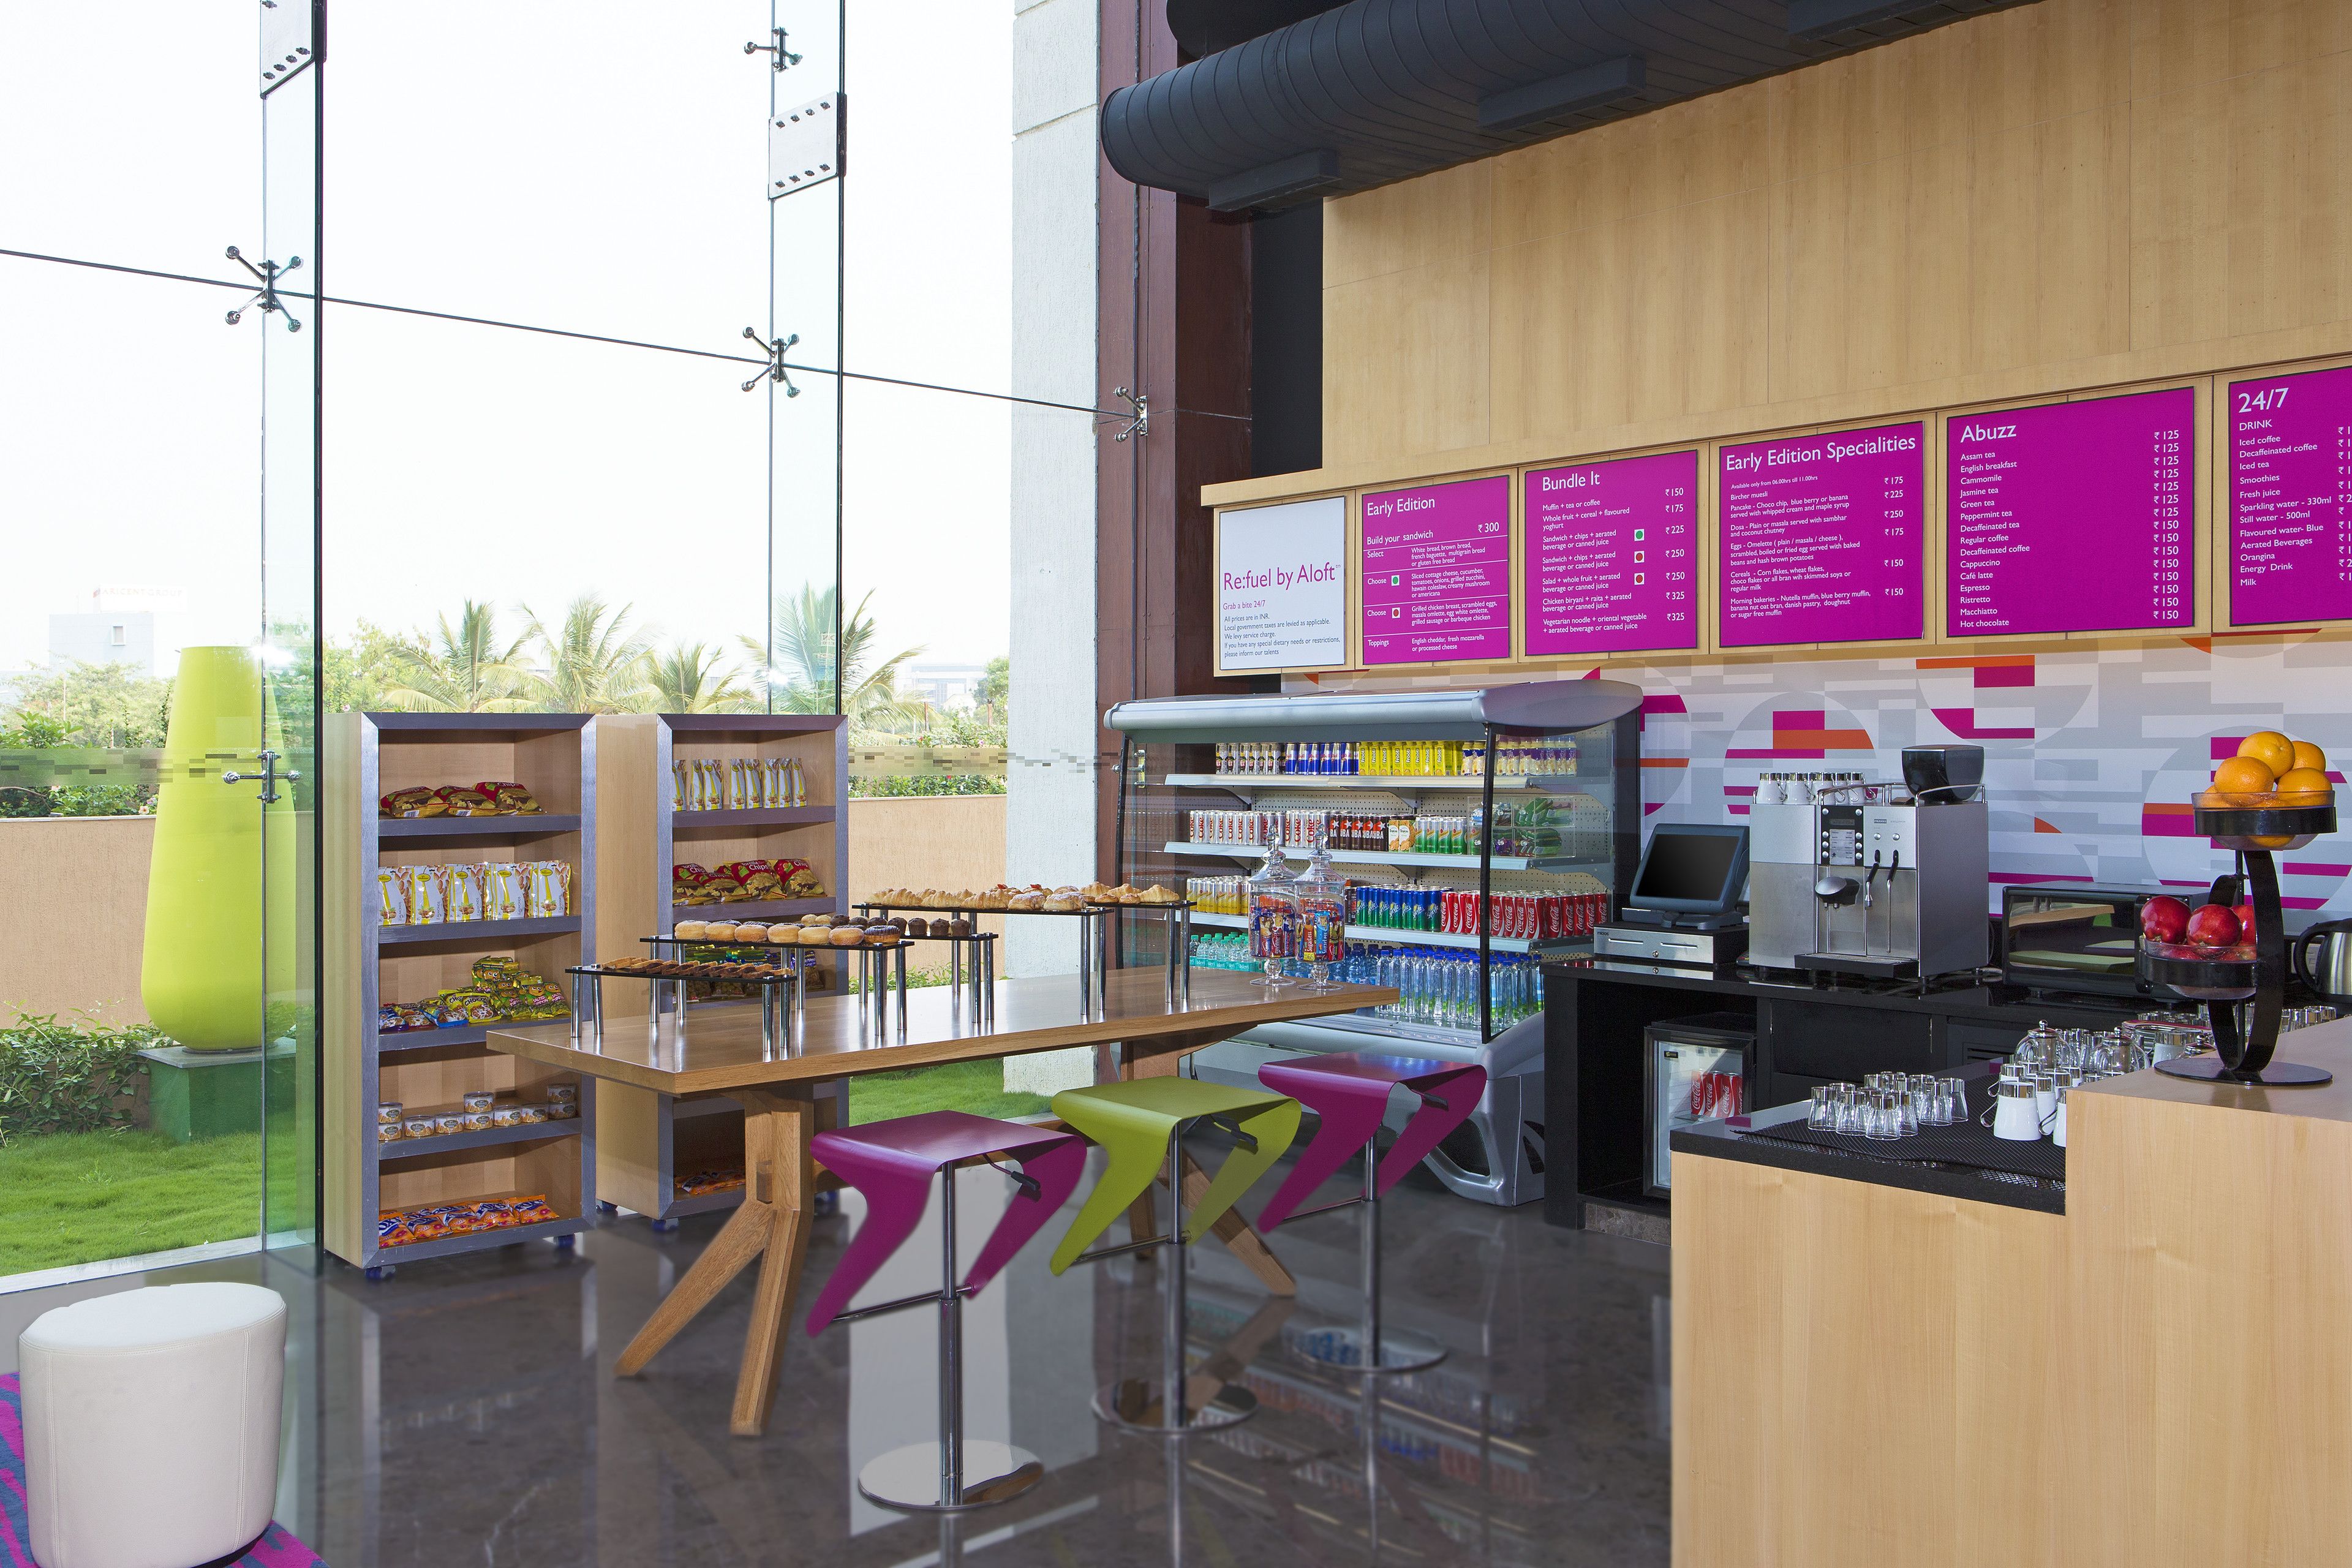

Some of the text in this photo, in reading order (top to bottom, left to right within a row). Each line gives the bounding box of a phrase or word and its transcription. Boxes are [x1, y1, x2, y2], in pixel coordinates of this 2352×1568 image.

[2238, 387, 2288, 413] 24/7
[2239, 419, 2272, 431] DRINK
[1960, 424, 2016, 443] Abuzz
[2239, 435, 2280, 446] Iced coffee
[1727, 435, 1915, 472] Early Edition Specialities
[2239, 443, 2317, 458] Decaffeinated coffee
[1961, 461, 2017, 473] English breakfast
[2239, 461, 2255, 470] Iced
[1542, 470, 1600, 491] Bundle It
[1960, 474, 2002, 484] Cammomile
[2240, 475, 2280, 484] Smoothies
[1960, 488, 1986, 498] Jasmine
[2263, 489, 2280, 498] juice
[1367, 497, 1434, 517] Early Edition
[2240, 502, 2274, 513] Sparkling
[2307, 496, 2331, 505] 330ml
[1604, 507, 1629, 516] flavoured
[1960, 511, 2000, 521] Peppermint
[2286, 510, 2310, 519] 500ml
[1542, 522, 1564, 532] yoghurt
[1960, 521, 2007, 532] Decaffeinated
[1366, 529, 1433, 545] Build your sandwich
[2240, 527, 2276, 537] Flavoured
[1960, 533, 2008, 545] Regular coffee
[2240, 540, 2271, 549] Aerated
[1960, 546, 2007, 556] Decaffeinated
[2240, 552, 2275, 562] Orangina
[1960, 559, 2000, 569] Cappuccino
[1224, 562, 1335, 590] Re:fuel by Aloft
[1960, 584, 1990, 593] Espresso
